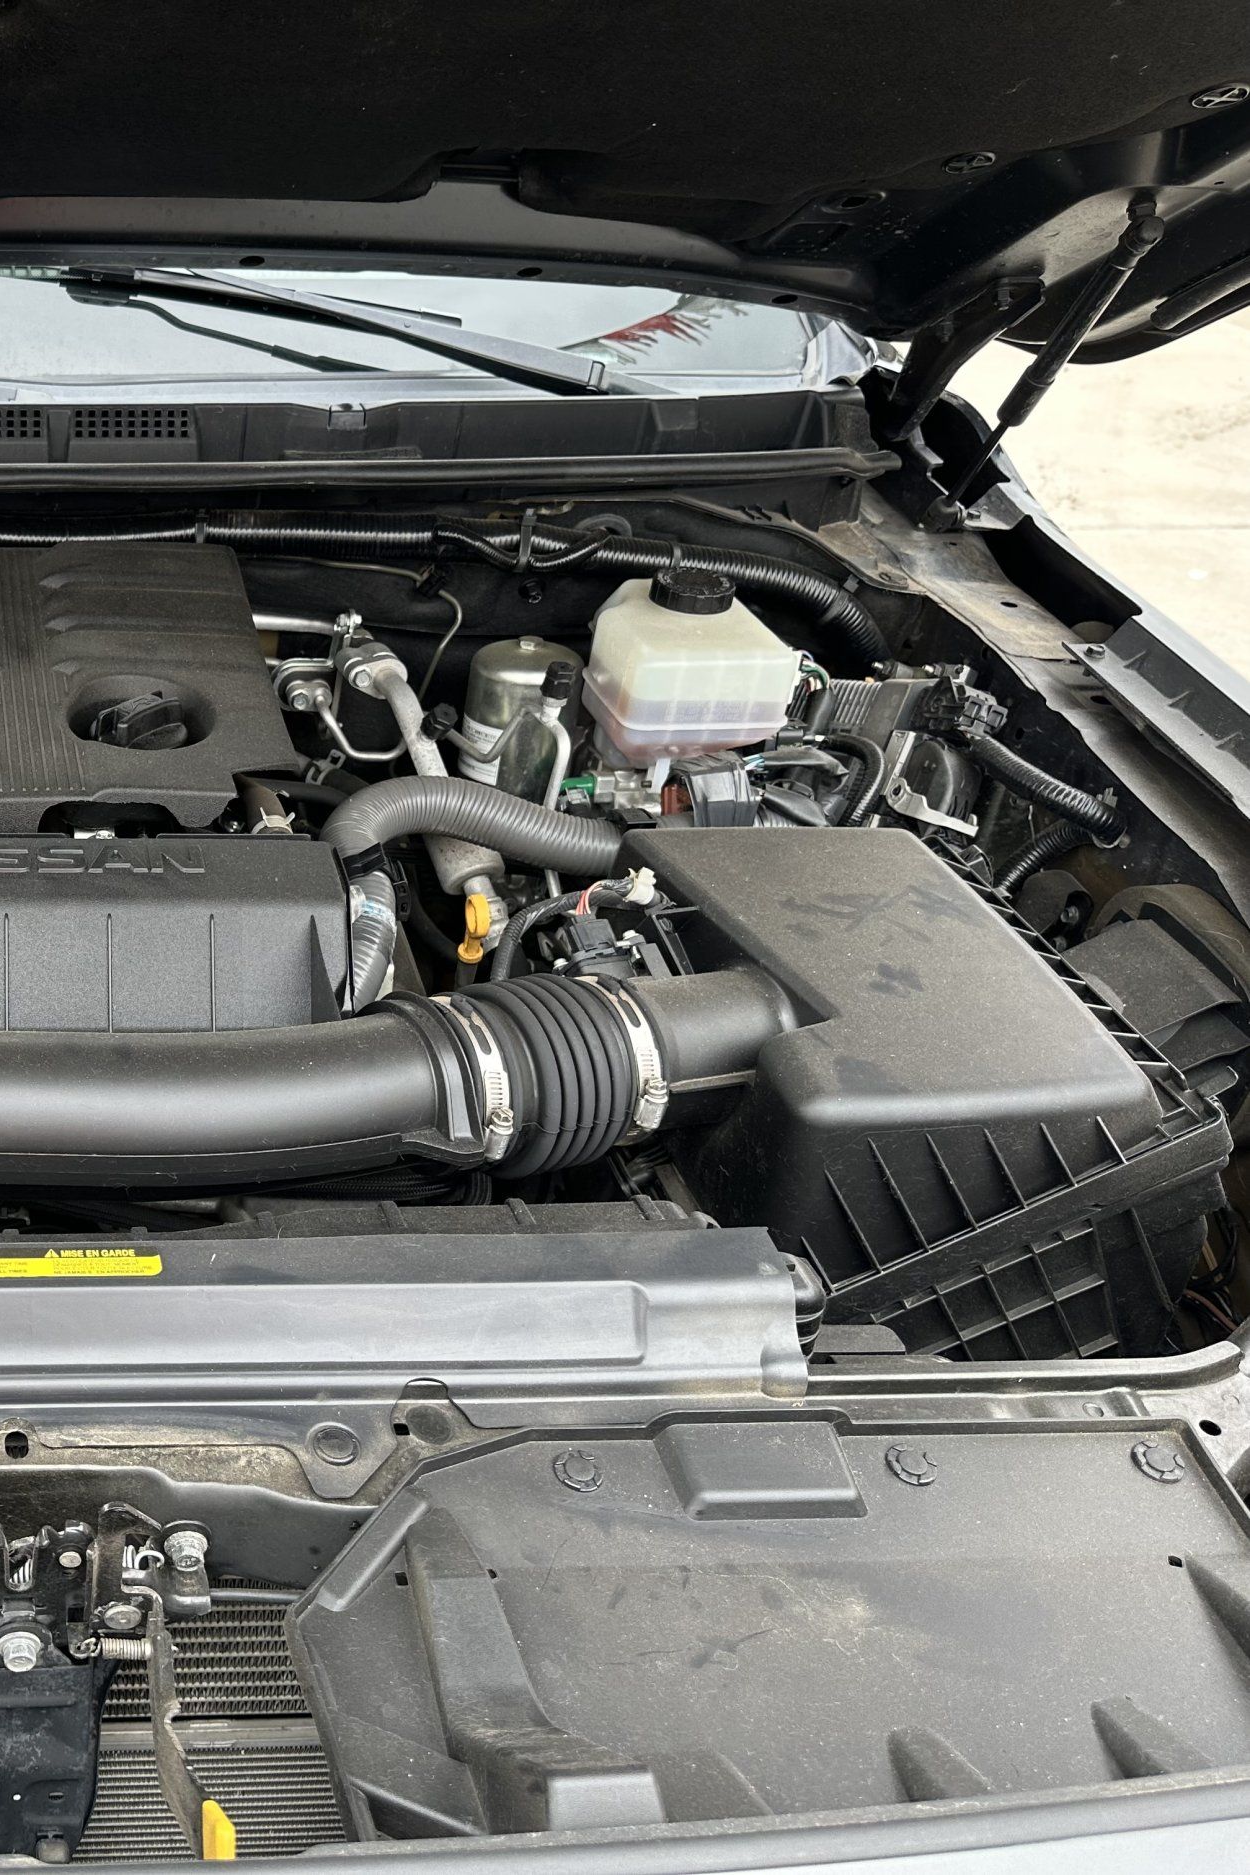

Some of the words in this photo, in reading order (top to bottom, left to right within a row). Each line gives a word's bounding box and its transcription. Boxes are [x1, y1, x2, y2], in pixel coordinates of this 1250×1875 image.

[60, 1249, 84, 1257] MISE
[85, 1249, 99, 1257] EN
[101, 1249, 136, 1257] GARDE
